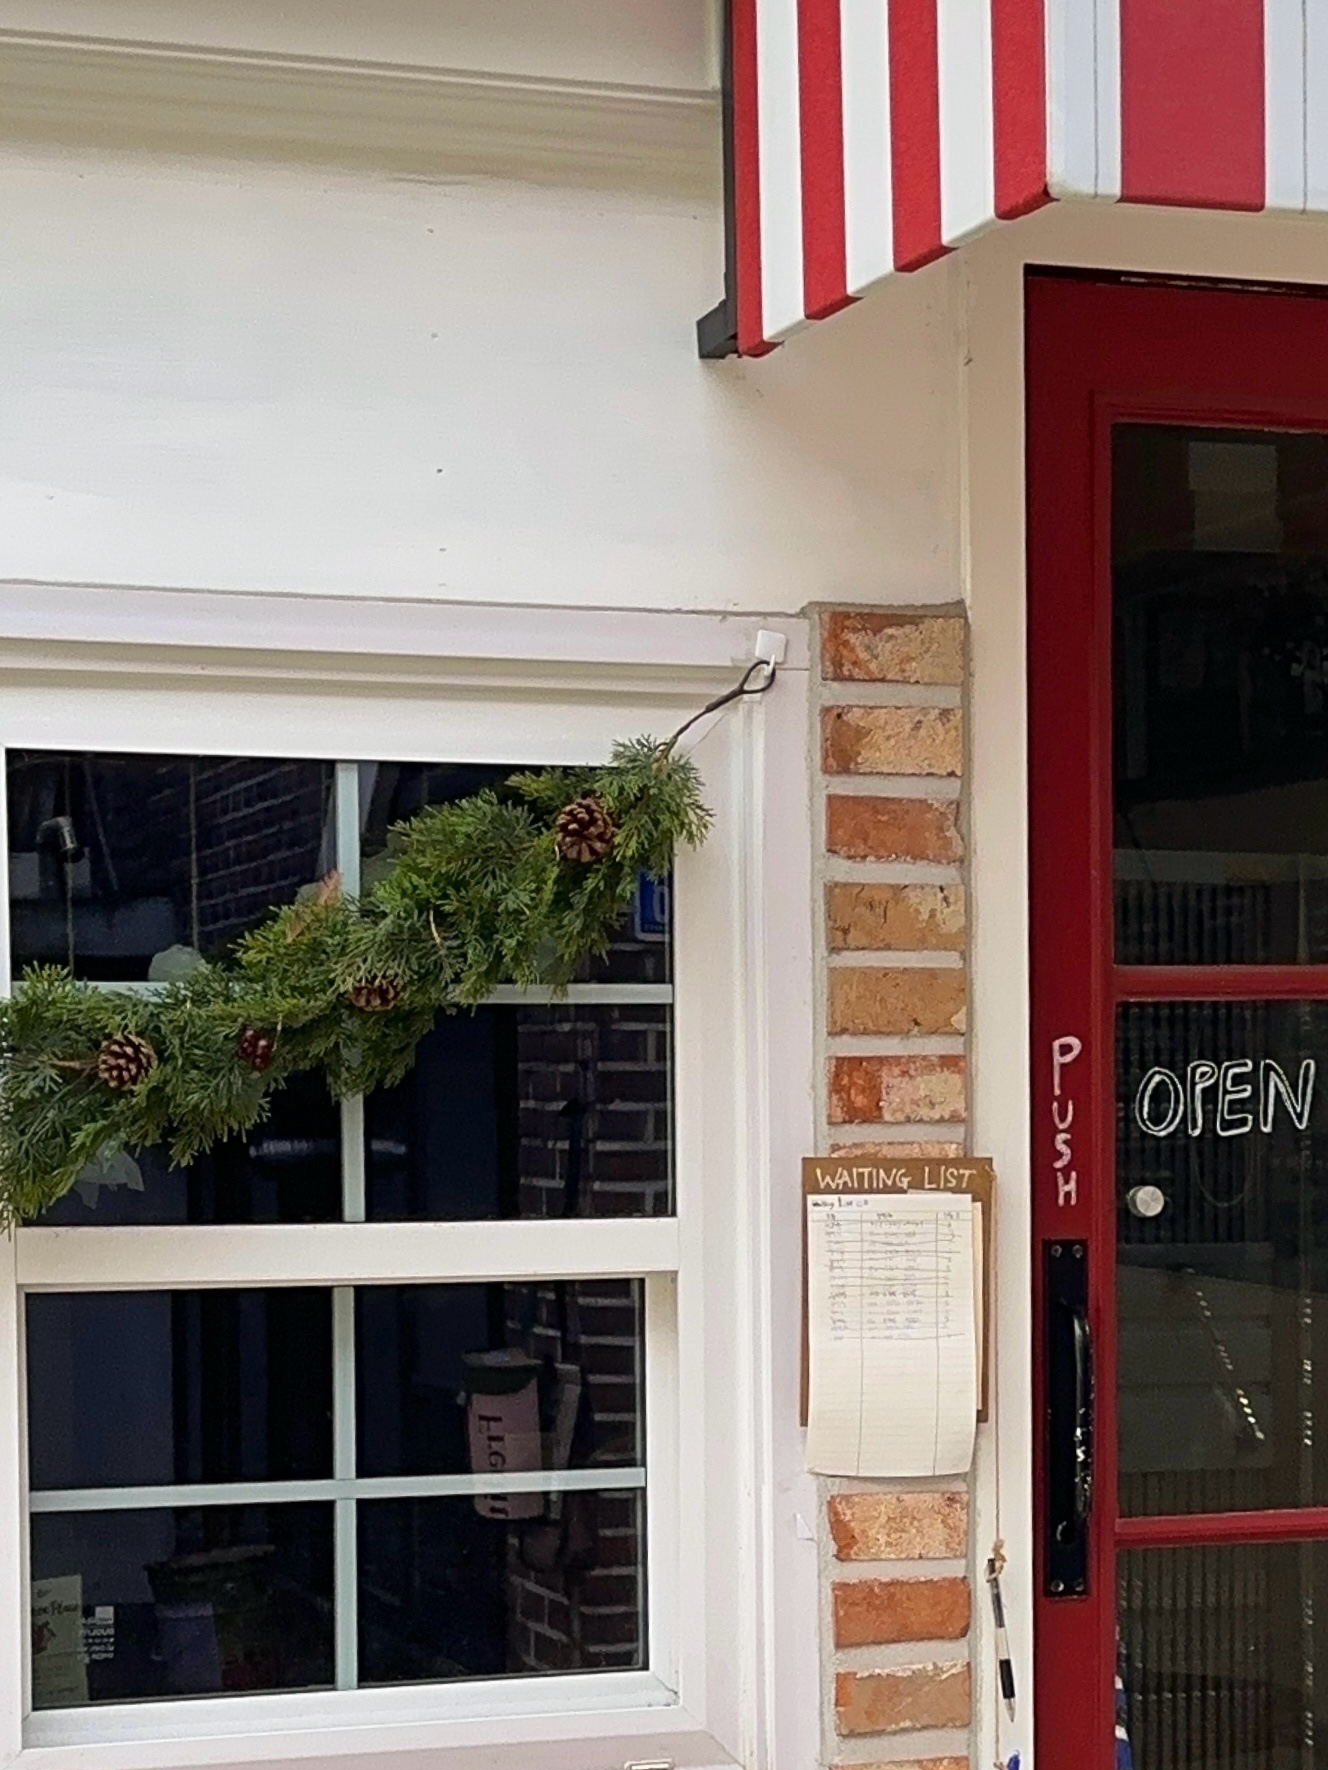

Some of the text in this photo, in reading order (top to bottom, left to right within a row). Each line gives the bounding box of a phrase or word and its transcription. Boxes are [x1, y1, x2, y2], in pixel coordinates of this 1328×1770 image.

[1051, 1035, 1083, 1207] PUSH
[1134, 1058, 1316, 1138] OPEN
[815, 1166, 977, 1191] WAITING LIST
